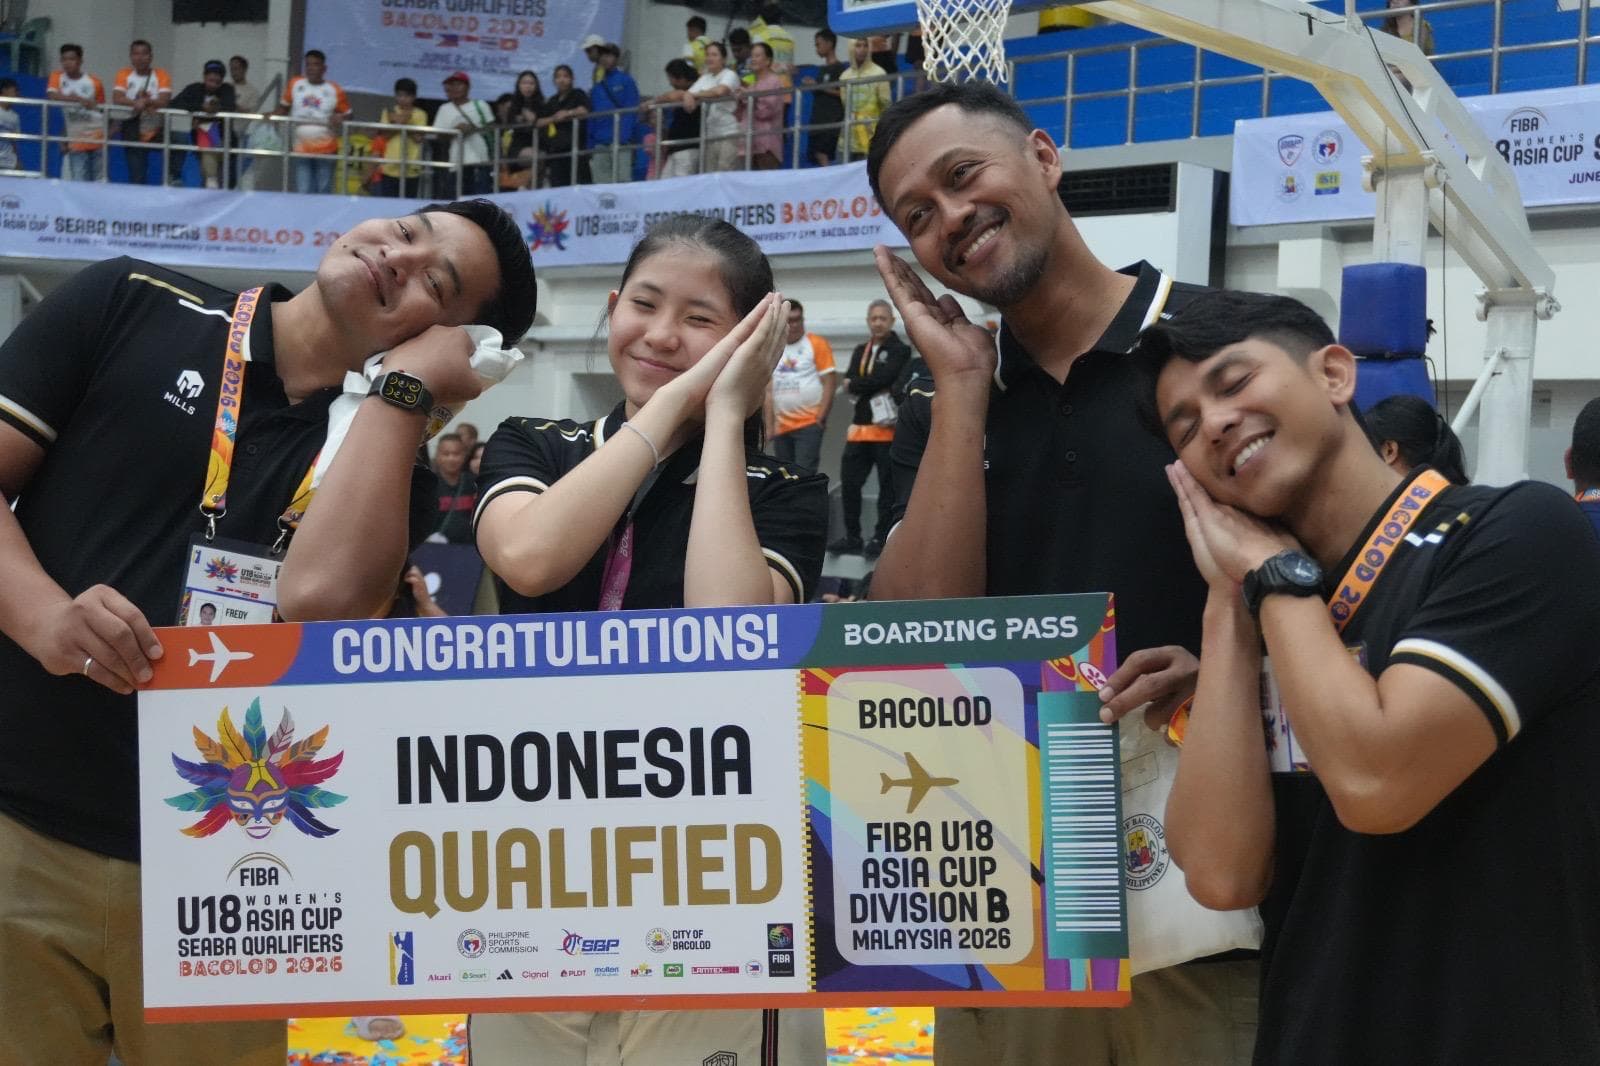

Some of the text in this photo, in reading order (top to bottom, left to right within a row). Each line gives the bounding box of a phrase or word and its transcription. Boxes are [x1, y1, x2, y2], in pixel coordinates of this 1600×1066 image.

[382, 11, 545, 37] BACOLOD 2026
[1510, 117, 1539, 133] FIBA
[1513, 133, 1584, 147] WOMEN'S
[1513, 147, 1548, 166] ASIA
[1553, 145, 1584, 162] CUP
[207, 226, 304, 245] BACOLOD
[576, 215, 600, 237] U18
[220, 358, 242, 408] 2026
[163, 391, 196, 415] MILLS
[1355, 485, 1431, 582] BACOLOD
[226, 608, 248, 620] FREDY
[844, 616, 1079, 645] BOARDING PASS
[332, 613, 779, 674] CONGRATULATIONS!
[858, 696, 992, 729] BACOLOD
[396, 724, 753, 804] INDONESIA
[866, 820, 994, 852] FIBA U18
[1132, 816, 1165, 840] BACOLOD
[240, 867, 279, 886] FIBA
[389, 823, 783, 919] QUALIFIED
[862, 856, 997, 888] ASIA CUP
[1127, 862, 1165, 888] HILIPPINES
[246, 892, 342, 906] WOMEN'S
[850, 888, 1010, 923] DIVISION B
[177, 894, 242, 935] U18
[246, 907, 343, 932] ASIA CUP
[178, 933, 343, 957] SEABA QUALIFIERS
[488, 931, 530, 939] PHILIPPINE
[672, 929, 704, 939] CITY OF
[672, 940, 711, 950] BACOLOD
[852, 928, 1011, 950] MALAYSIA 2026
[581, 939, 620, 952] SBP
[179, 956, 343, 976] BACOLOD 2026
[594, 966, 619, 974] molten
[772, 954, 790, 964] FIBA
[428, 973, 452, 981] Akari
[521, 970, 549, 980] Cignal
